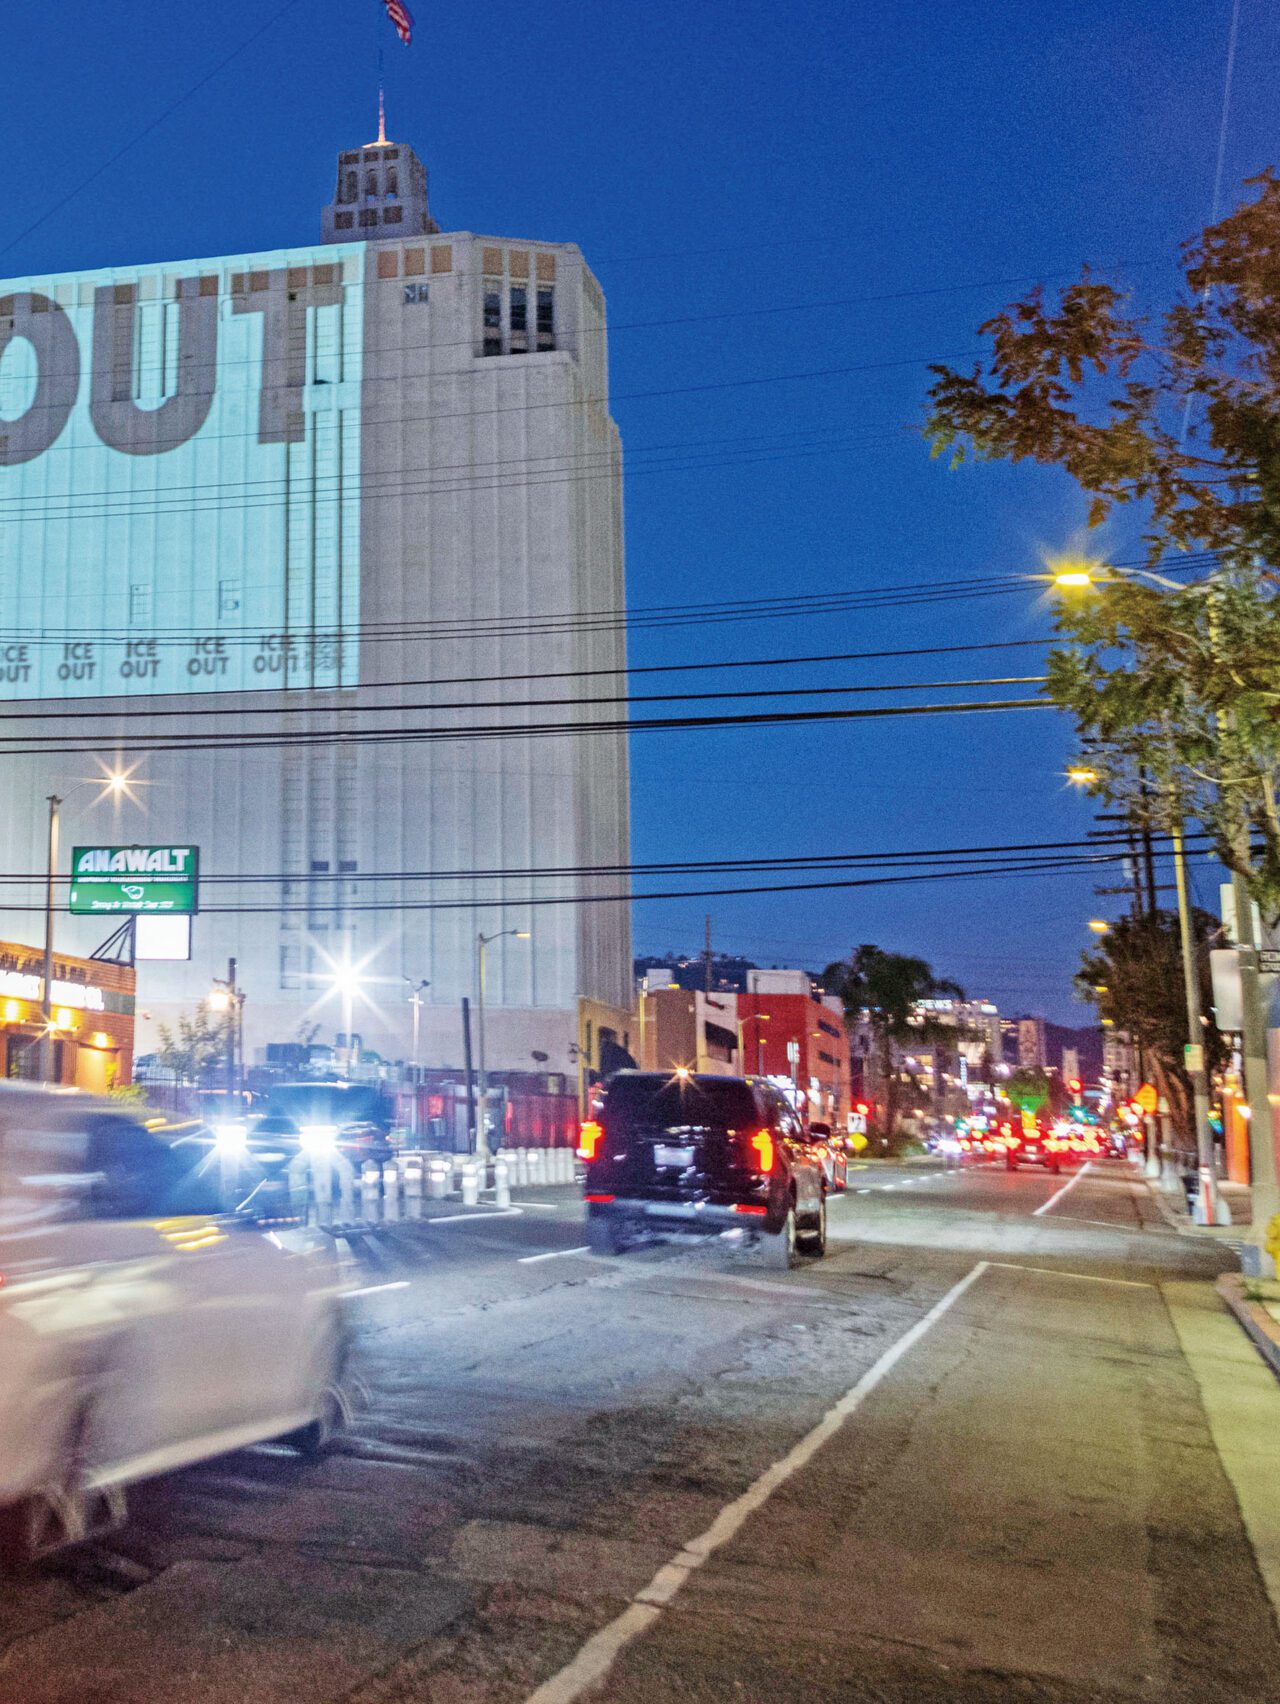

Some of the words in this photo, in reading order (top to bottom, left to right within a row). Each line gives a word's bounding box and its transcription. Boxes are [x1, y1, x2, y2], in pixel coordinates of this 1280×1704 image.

[63, 642, 94, 661] ICE
[126, 639, 158, 658] ICE
[195, 636, 226, 655] ICE
[260, 633, 297, 653] ICE
[57, 662, 96, 680] OUT
[120, 659, 160, 678] OUT
[186, 656, 230, 676] OUT
[253, 653, 299, 673] OUT
[77, 848, 190, 872] ANAWALT
